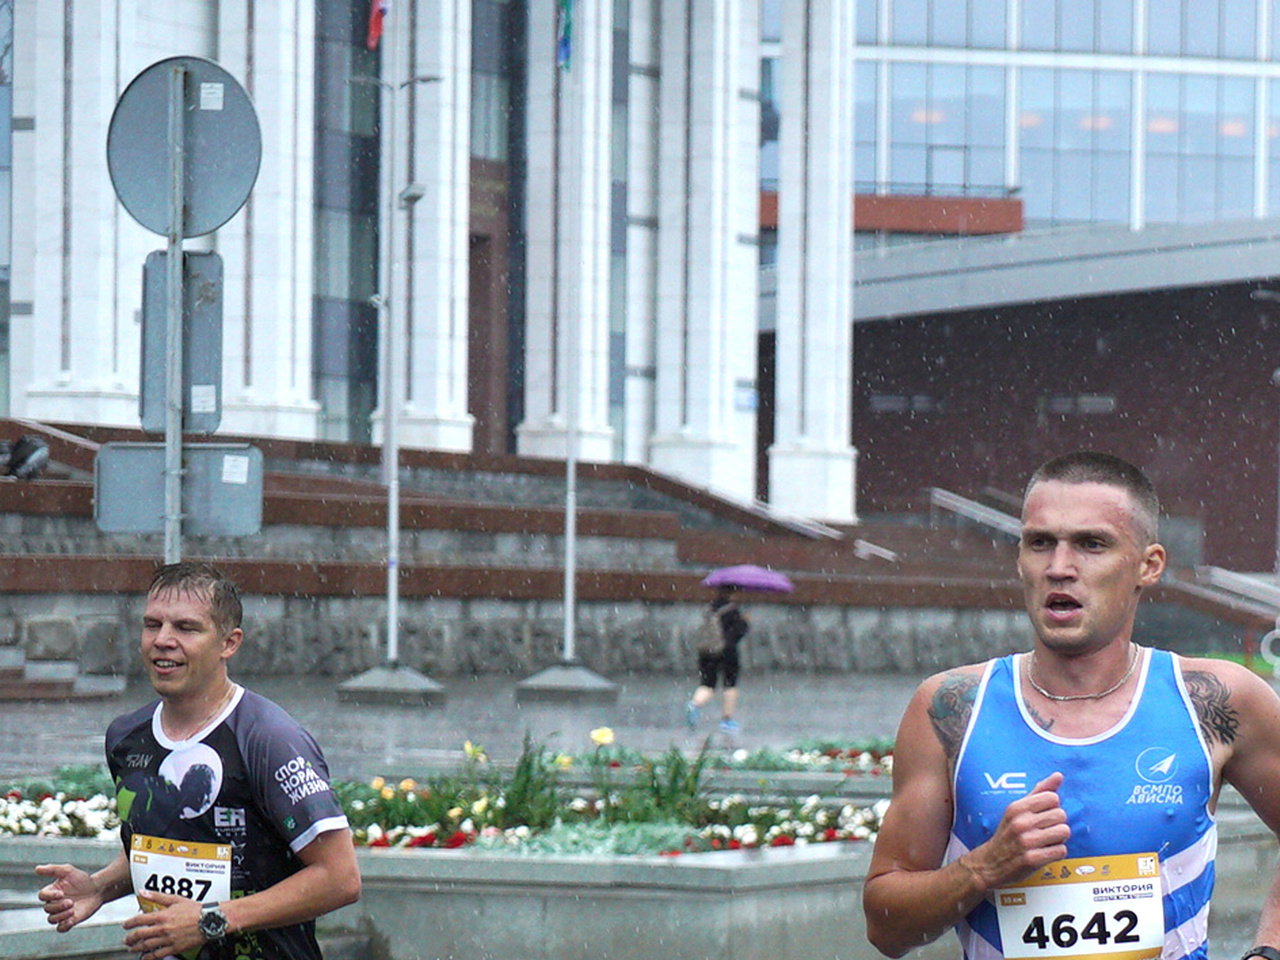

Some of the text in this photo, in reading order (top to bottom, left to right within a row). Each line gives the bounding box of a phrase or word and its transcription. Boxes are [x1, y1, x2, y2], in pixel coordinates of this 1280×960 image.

[984, 772, 1027, 789] VC
[1133, 784, 1183, 795] ВСМПО
[1125, 793, 1183, 805] АВИСМА
[144, 873, 212, 902] 4887
[1092, 883, 1154, 895] ВИКТОРИЯ
[1022, 909, 1140, 949] 4642
